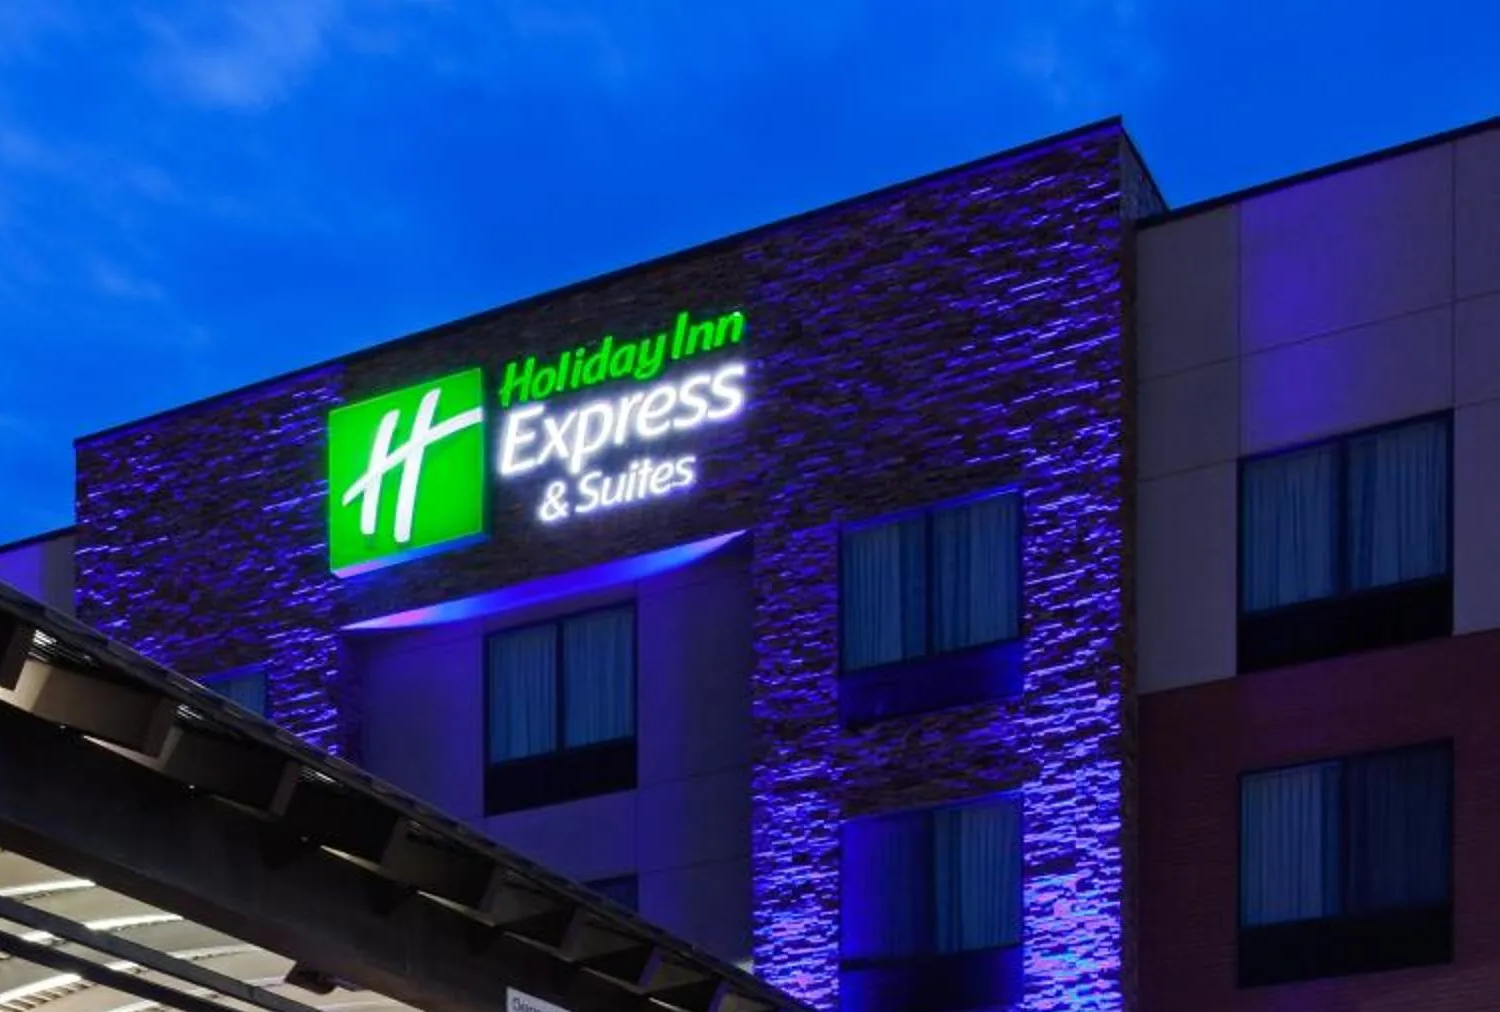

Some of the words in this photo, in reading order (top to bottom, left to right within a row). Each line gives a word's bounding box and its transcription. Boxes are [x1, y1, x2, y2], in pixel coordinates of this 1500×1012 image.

[502, 337, 666, 407] Holiday
[672, 311, 744, 359] Inn
[501, 364, 745, 477] Express
[539, 481, 569, 521] &
[575, 456, 696, 513] Suites
